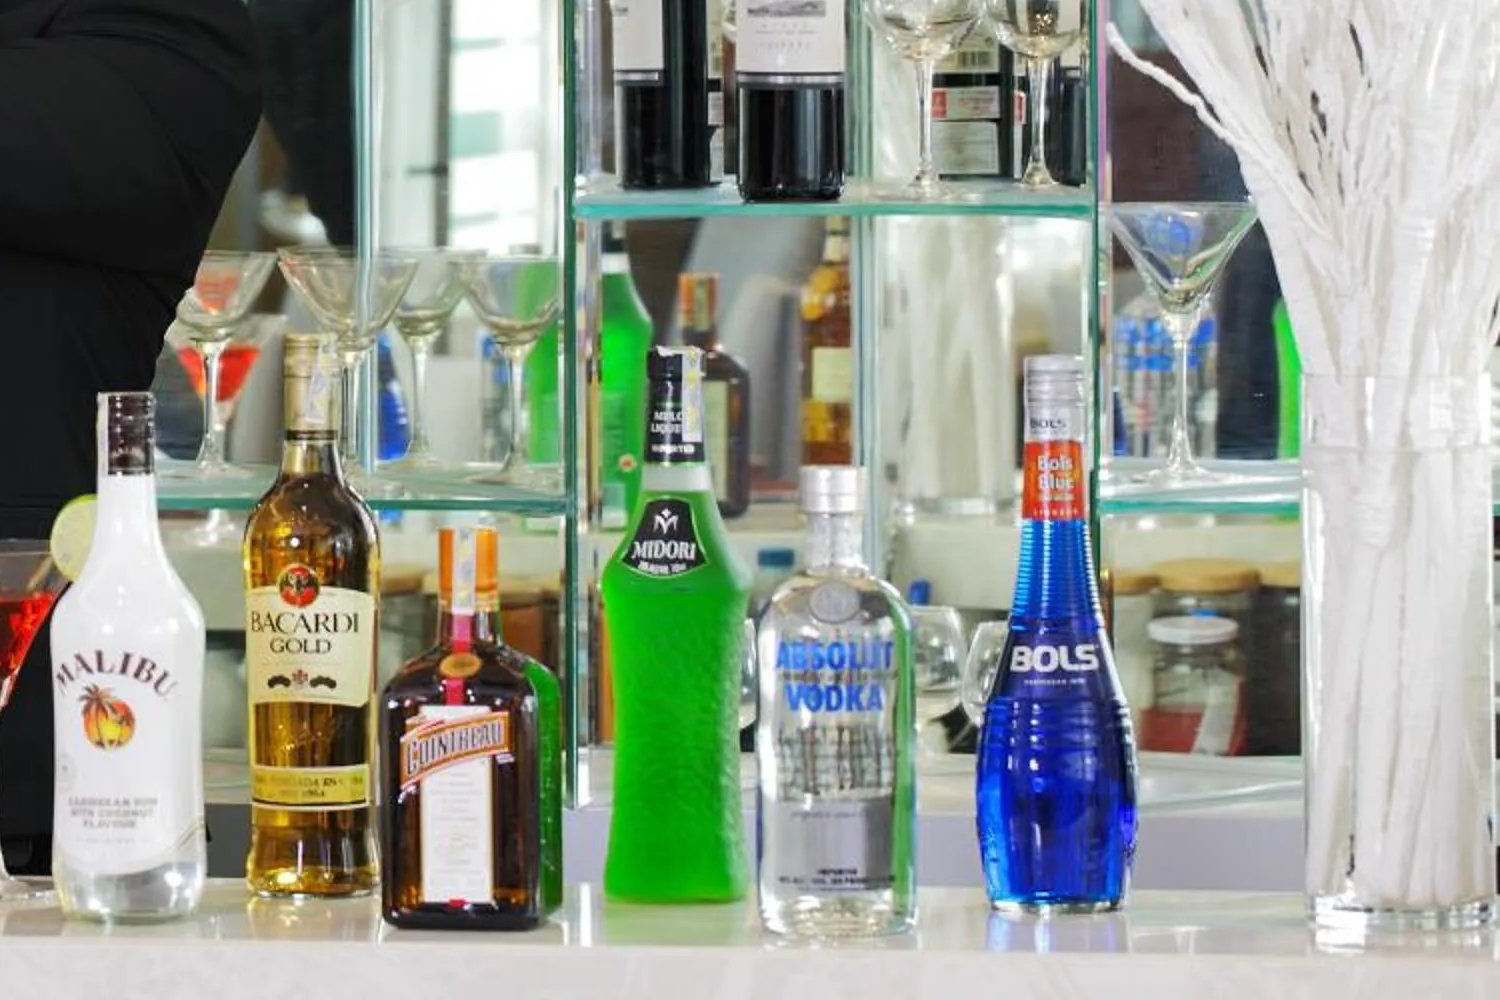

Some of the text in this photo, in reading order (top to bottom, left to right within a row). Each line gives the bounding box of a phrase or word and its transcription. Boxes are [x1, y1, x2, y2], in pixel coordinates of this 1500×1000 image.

[632, 539, 697, 560] MIDORI
[251, 611, 360, 634] BACARDI
[269, 636, 332, 655] GOLD
[776, 641, 894, 670] ABSOLUT
[1009, 643, 1100, 673] BOLS
[55, 650, 179, 698] MALIBU
[786, 684, 884, 712] VODKA
[406, 718, 504, 776] COINTREAU
